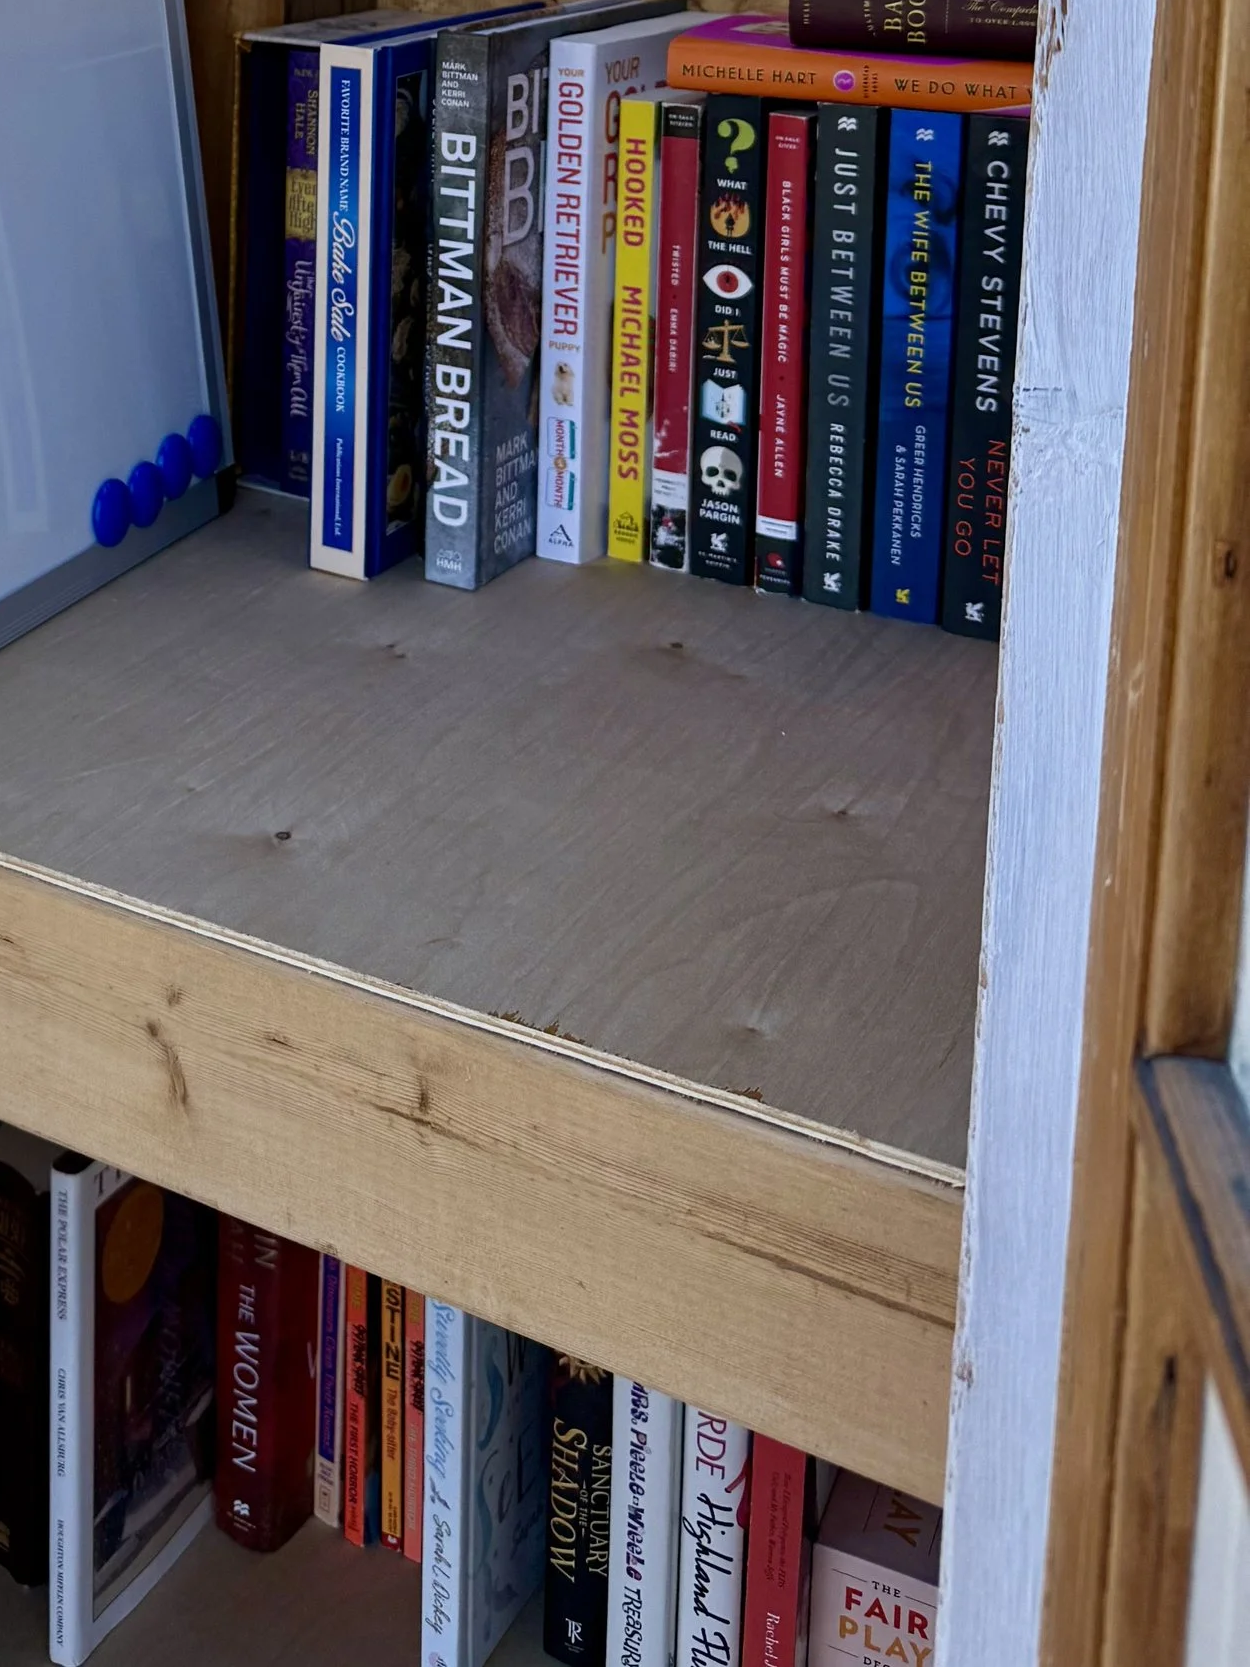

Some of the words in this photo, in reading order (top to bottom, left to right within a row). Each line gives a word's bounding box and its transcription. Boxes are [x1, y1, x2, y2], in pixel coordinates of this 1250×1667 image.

[441, 70, 479, 82] BITTMAN
[441, 80, 459, 88] AND
[442, 61, 467, 71] MARK
[558, 68, 585, 78] YOUR
[604, 56, 641, 84] YOUR
[682, 64, 764, 82] MICHELLE
[772, 70, 817, 86] HART
[340, 79, 351, 135] FAVORITE
[441, 89, 466, 98] KERRI
[441, 98, 470, 107] CONAN
[894, 78, 920, 93] WE
[929, 81, 955, 95] DO
[965, 84, 1018, 100] WHAT
[294, 102, 305, 140] HALE
[306, 89, 318, 155] SHANNON
[556, 81, 584, 185] GOLDEN
[339, 136, 350, 177] BRAND
[338, 178, 349, 212] NAME
[622, 137, 647, 248] HOOKED
[716, 177, 747, 191] WHAT
[781, 180, 792, 221] BLACK
[833, 148, 859, 215] JUST
[914, 161, 932, 202] THE
[982, 161, 1009, 265] CHEVY
[331, 211, 355, 285] Bake
[436, 132, 477, 350] BITTMAN
[707, 240, 727, 252] THE
[728, 242, 752, 255] HELL
[780, 226, 792, 262] GIRLS
[911, 210, 930, 263] WIFE
[553, 192, 581, 336] RETRIEVER
[671, 244, 681, 286] TWISTED
[779, 267, 791, 299] MUST
[330, 288, 354, 342] Sale
[714, 304, 732, 315] DID
[778, 304, 791, 320] BE
[828, 230, 855, 359] BETWEEN
[619, 285, 642, 398] MICHAEL
[669, 308, 678, 336] EMMA
[777, 322, 790, 363] MAGIC
[906, 271, 928, 375] BETWEEN
[548, 340, 581, 353] PUPPY
[975, 275, 1004, 412] STEVENS
[335, 346, 347, 413] COOKBOOK
[712, 367, 737, 379] JUST
[827, 374, 852, 407] US
[775, 394, 787, 434] JAYNE
[904, 382, 923, 408] US
[433, 363, 471, 528] BREAD
[495, 431, 528, 463] MARK
[617, 407, 641, 482] MOSS
[709, 428, 737, 442] READ
[895, 444, 907, 453] &
[913, 424, 926, 466] GREER
[495, 449, 537, 486] BITTMA
[774, 437, 786, 478] ALLEN
[827, 422, 845, 498] REBECCA
[894, 457, 906, 497] SARAH
[494, 482, 519, 511] AND
[910, 467, 924, 538] HENDRICKS
[957, 457, 976, 510] YOU
[984, 439, 1007, 529] NEVER
[494, 497, 527, 533] KERRI
[699, 508, 741, 525] PARGIN
[700, 498, 739, 514] JASON
[493, 517, 532, 555] CONAN
[547, 537, 574, 548] ALPHA
[825, 507, 843, 562] DRAKE
[890, 499, 905, 565] PEKKANEN
[955, 520, 973, 556] GO
[981, 538, 1001, 586] LET
[57, 1189, 69, 1219] THE
[56, 1219, 69, 1264] POLAR
[56, 1266, 68, 1321] EXPRESS
[239, 1284, 256, 1325] THE
[385, 1286, 400, 1381] STINE
[56, 1368, 67, 1399] CHRIS
[232, 1331, 260, 1473] WOMEN
[386, 1388, 398, 1406] The
[56, 1401, 66, 1420] VAN
[348, 1402, 359, 1425] THE
[56, 1421, 66, 1477] ALLSBURG
[348, 1425, 358, 1454] FIRST
[426, 1386, 454, 1481] Seeking
[695, 1409, 728, 1481] RDE
[347, 1454, 358, 1505] HORROR
[549, 1416, 589, 1583] SHADOW
[580, 1489, 588, 1505] OF
[579, 1507, 588, 1527] THE
[588, 1444, 612, 1578] SANCTUARY
[883, 1490, 924, 1548] AY
[55, 1519, 65, 1568] HOUGHTON
[432, 1514, 451, 1564] Sarah
[682, 1492, 735, 1626] Highland
[55, 1570, 64, 1605] MIFFLIN
[424, 1580, 451, 1635] Dickey
[871, 1580, 902, 1598] THE
[55, 1605, 64, 1647] COMPANY
[766, 1612, 781, 1655] Rachel
[845, 1586, 929, 1640] FAIR
[838, 1614, 934, 1667] PLAY
